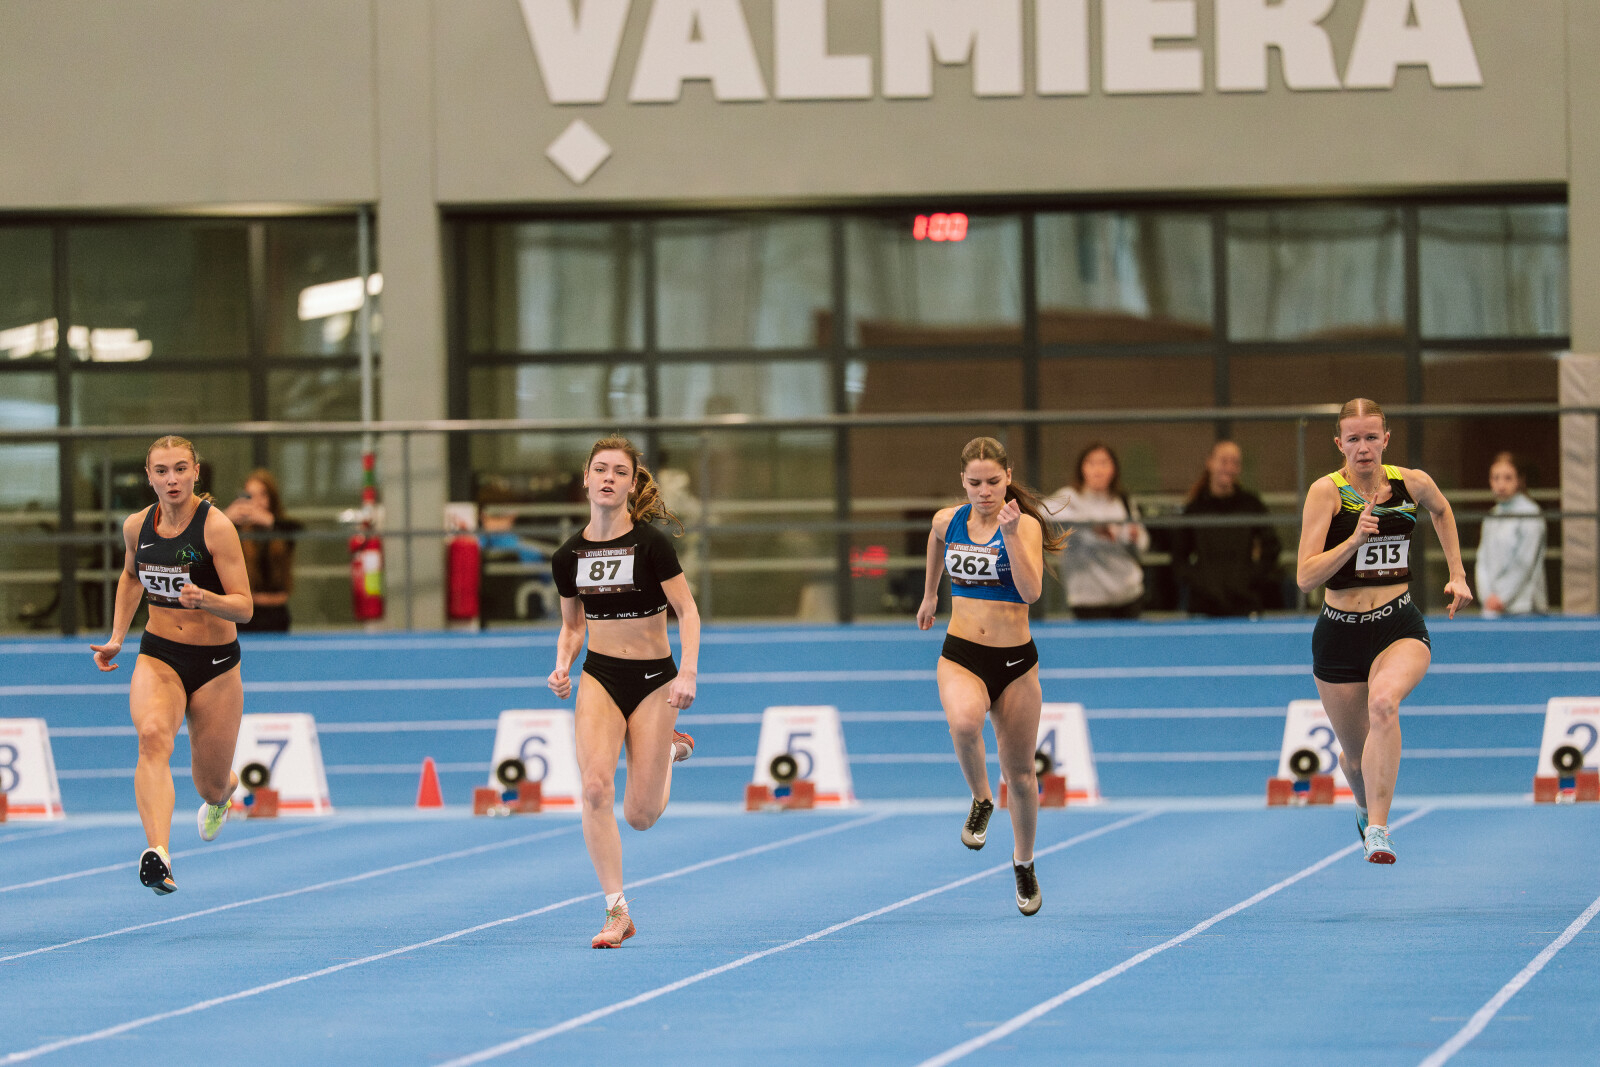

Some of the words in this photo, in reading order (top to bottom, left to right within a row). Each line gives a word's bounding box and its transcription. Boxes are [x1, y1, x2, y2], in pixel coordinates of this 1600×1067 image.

[520, 0, 1484, 104] VALMIERA
[589, 559, 622, 581] 87
[950, 553, 992, 576] 262
[1364, 544, 1401, 566] 513
[144, 574, 185, 593] 376
[1323, 607, 1358, 624] NIKE
[1360, 605, 1393, 624] PRO
[256, 739, 289, 774] 7
[519, 735, 549, 783] 6
[787, 732, 814, 779] 5
[1037, 728, 1063, 773] 4
[1308, 726, 1339, 775] 3
[1567, 722, 1599, 772] 2
